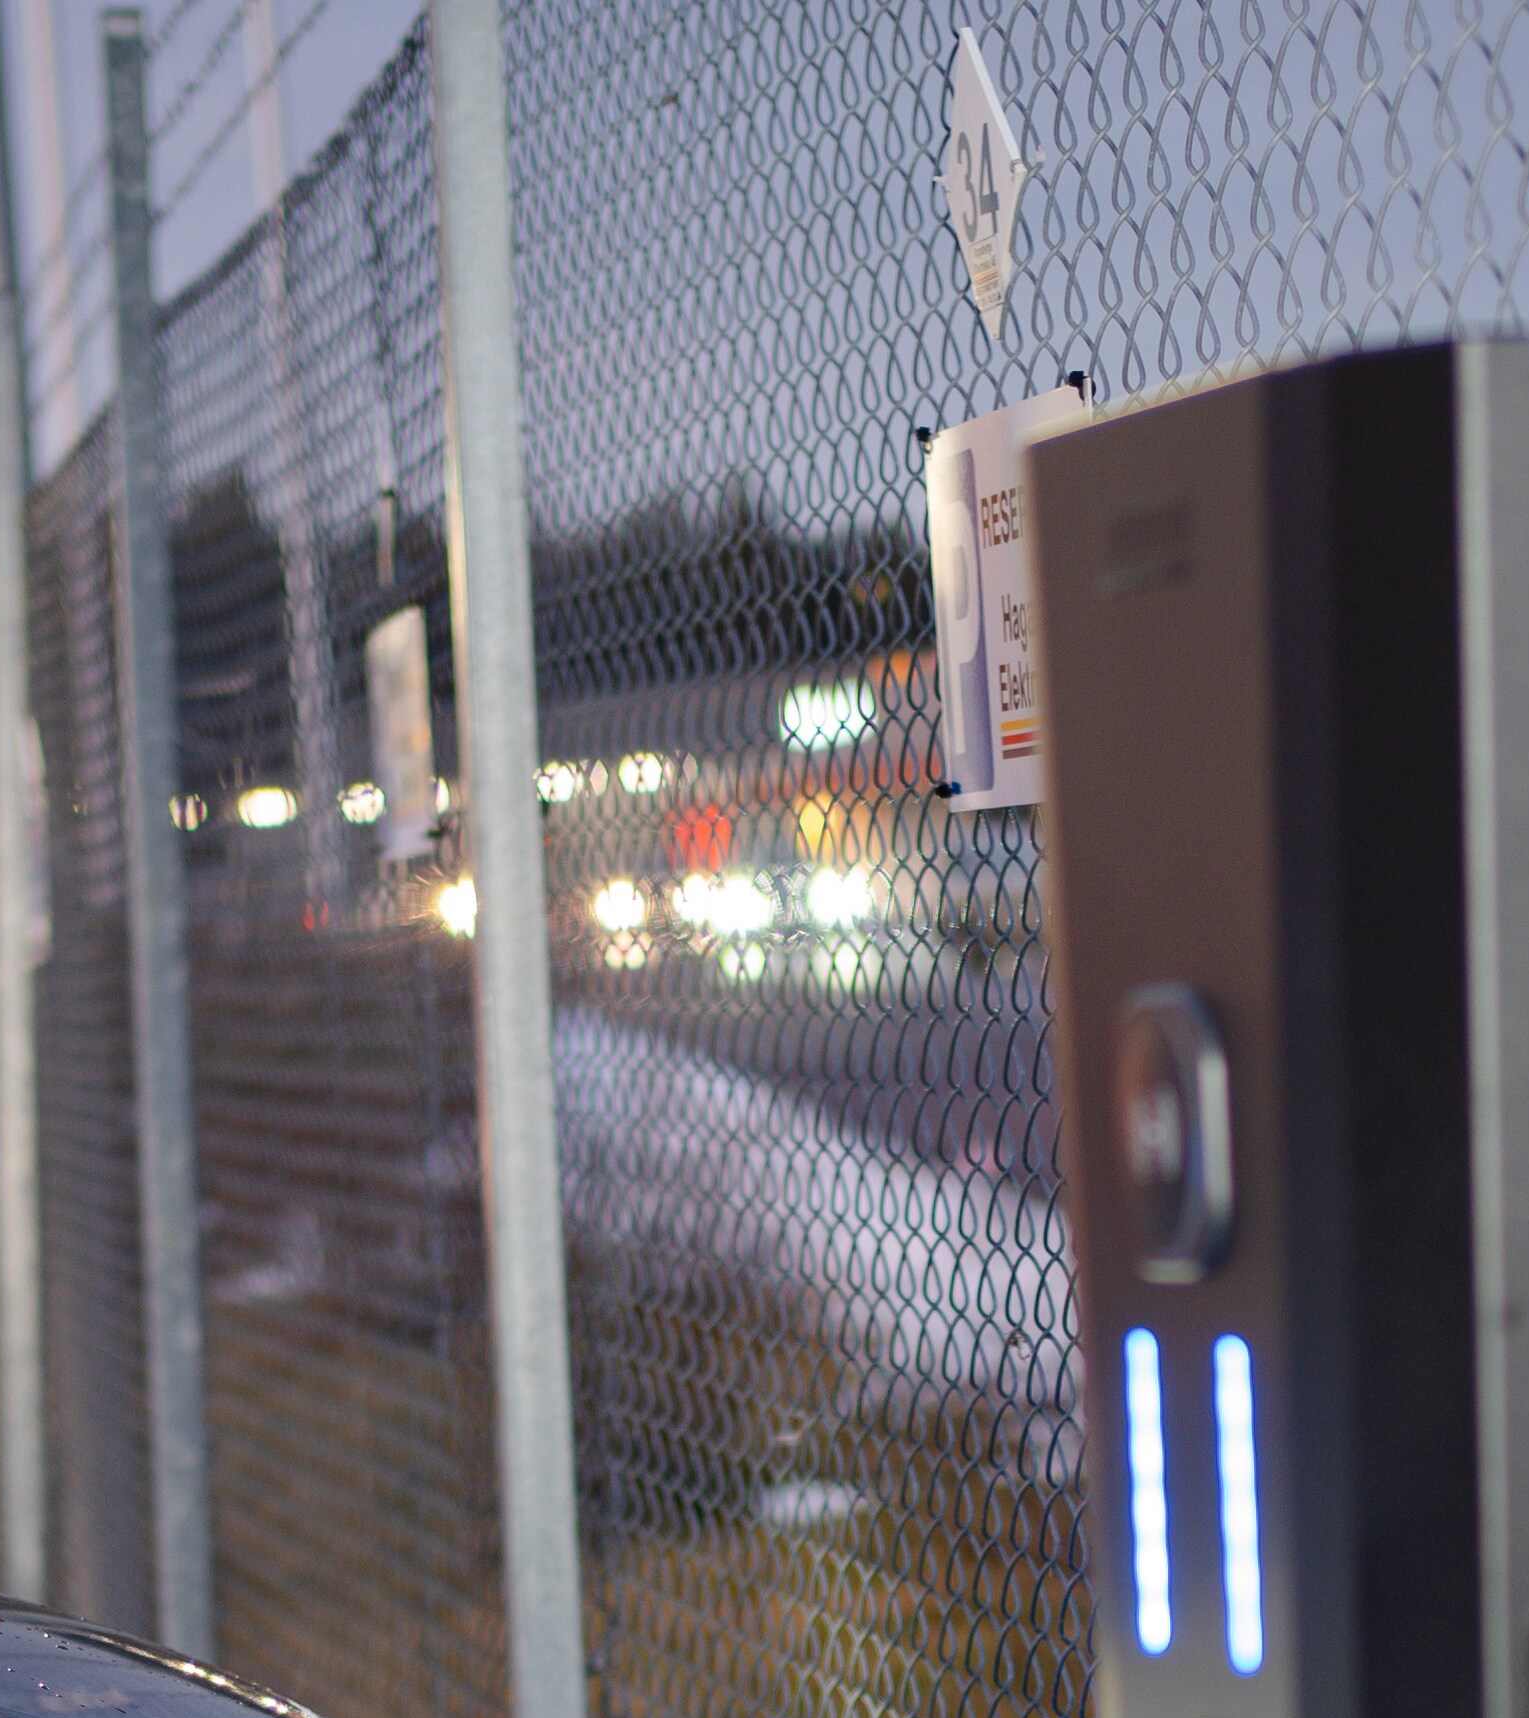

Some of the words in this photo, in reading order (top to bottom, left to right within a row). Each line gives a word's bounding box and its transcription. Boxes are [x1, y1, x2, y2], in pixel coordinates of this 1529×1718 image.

[957, 122, 1000, 243] 34
[1001, 593, 1031, 652] Hag
[999, 661, 1035, 712] Elektr
